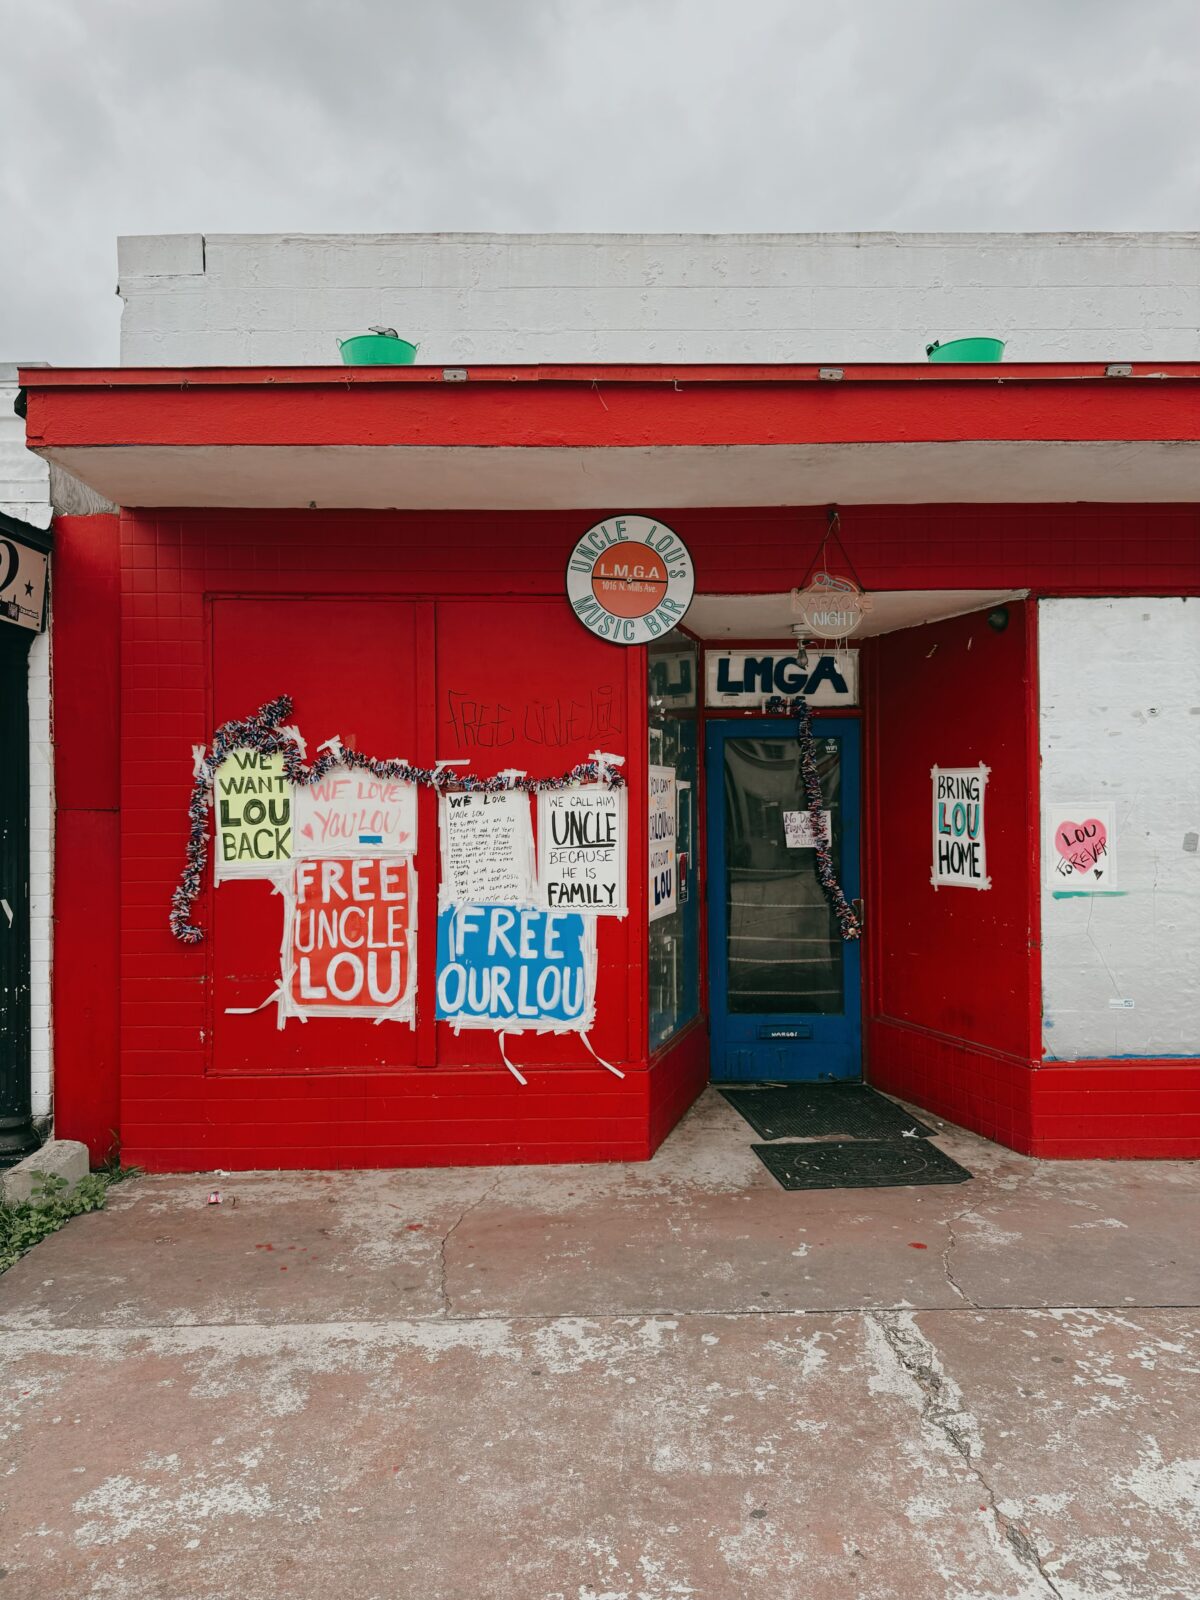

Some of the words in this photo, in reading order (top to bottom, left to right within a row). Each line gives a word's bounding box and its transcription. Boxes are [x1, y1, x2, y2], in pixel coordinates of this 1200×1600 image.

[570, 520, 629, 573] UNCLE
[645, 525, 687, 579] LOU'S
[600, 563, 660, 579] L.M.G.A
[628, 583, 643, 592] Mills
[573, 594, 635, 641] MUSIC
[643, 598, 686, 636] BAR
[813, 611, 857, 626] NIGHT
[717, 656, 849, 694] LMGA
[442, 689, 515, 748] FREE
[233, 752, 272, 770] WE
[219, 775, 287, 795] WANT
[309, 780, 352, 801] WE
[357, 781, 403, 803] LOVE
[449, 795, 472, 808] WE
[549, 796, 564, 807] WE
[570, 797, 592, 807] CALL
[596, 796, 615, 808] HIM
[937, 776, 980, 801] BRING
[220, 799, 290, 827] LOU
[314, 808, 356, 843] YOU
[358, 809, 400, 834] LOU
[552, 811, 617, 846] UNCLE
[938, 802, 980, 839] LOU
[222, 827, 291, 861] BACK
[1062, 824, 1096, 846] LOU
[549, 849, 615, 864] BECAUSE
[562, 867, 577, 878] HE
[586, 867, 596, 879] IS
[938, 842, 981, 878] HOME
[296, 859, 406, 904] FREE
[547, 882, 616, 906] FAMILY
[654, 868, 672, 906] LOU
[295, 906, 405, 953] UNCLE
[456, 906, 568, 959] FREE
[300, 950, 401, 1003] LOU
[437, 963, 514, 1013] OUR
[518, 965, 583, 1016] LOU
